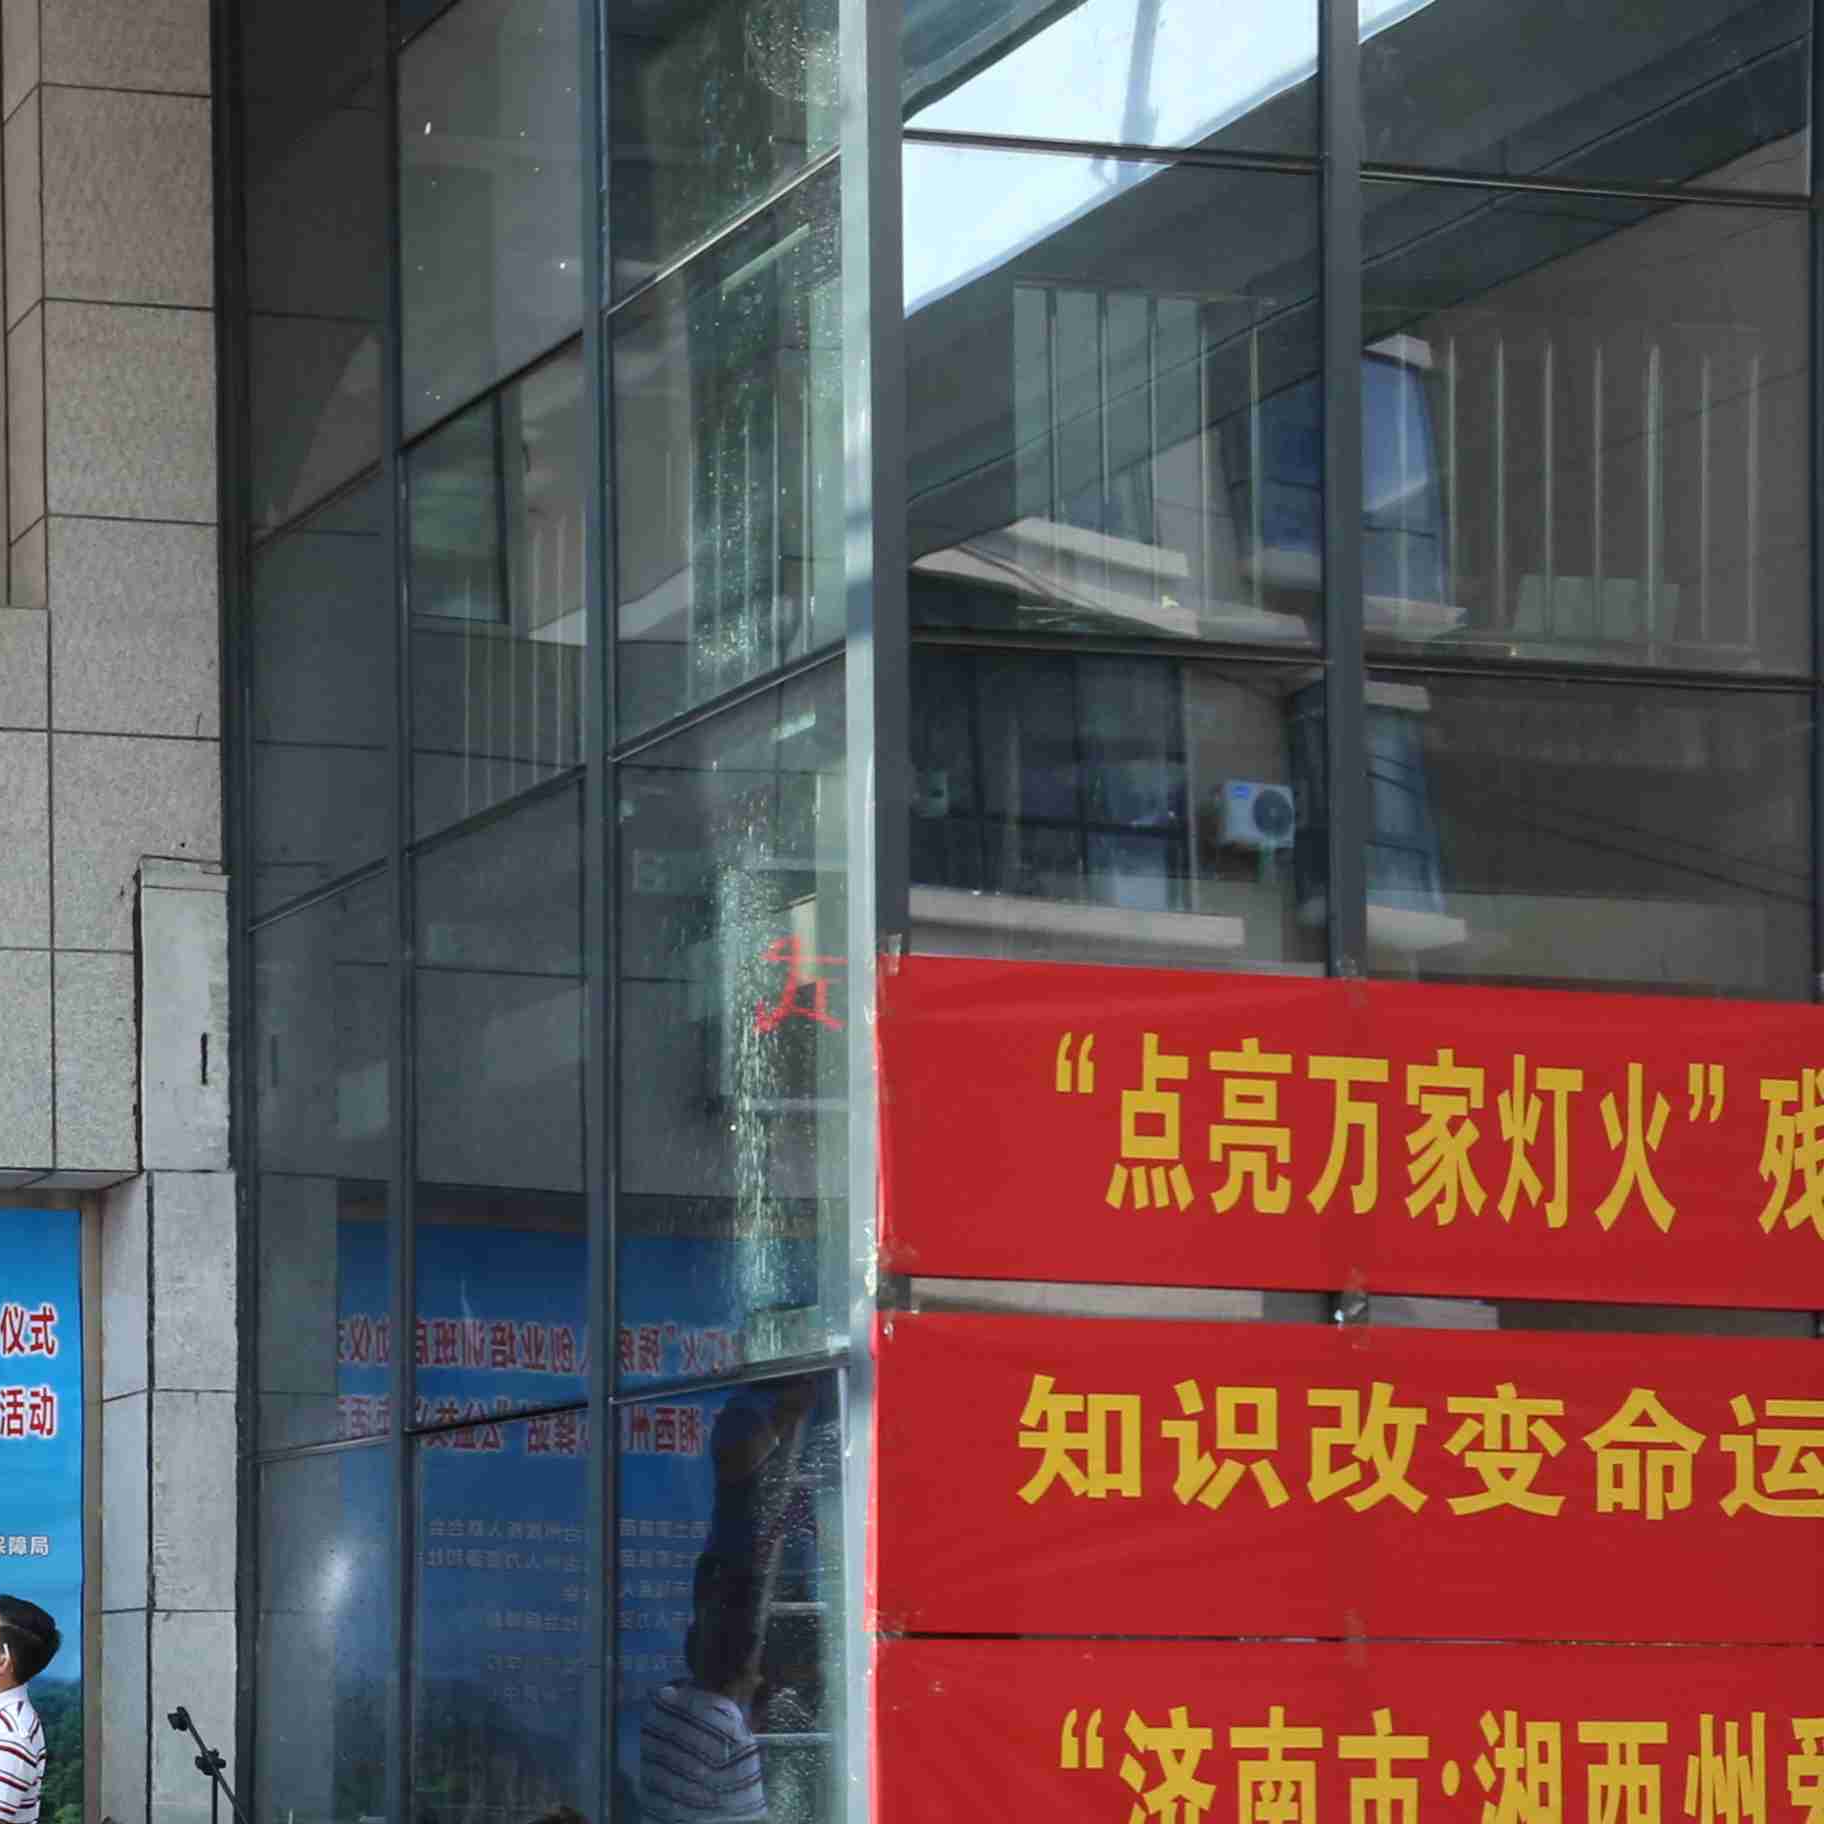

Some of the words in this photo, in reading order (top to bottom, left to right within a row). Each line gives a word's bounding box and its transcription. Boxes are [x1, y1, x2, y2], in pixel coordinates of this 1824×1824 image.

[1017, 1374, 1824, 1521] 知识改变命运
